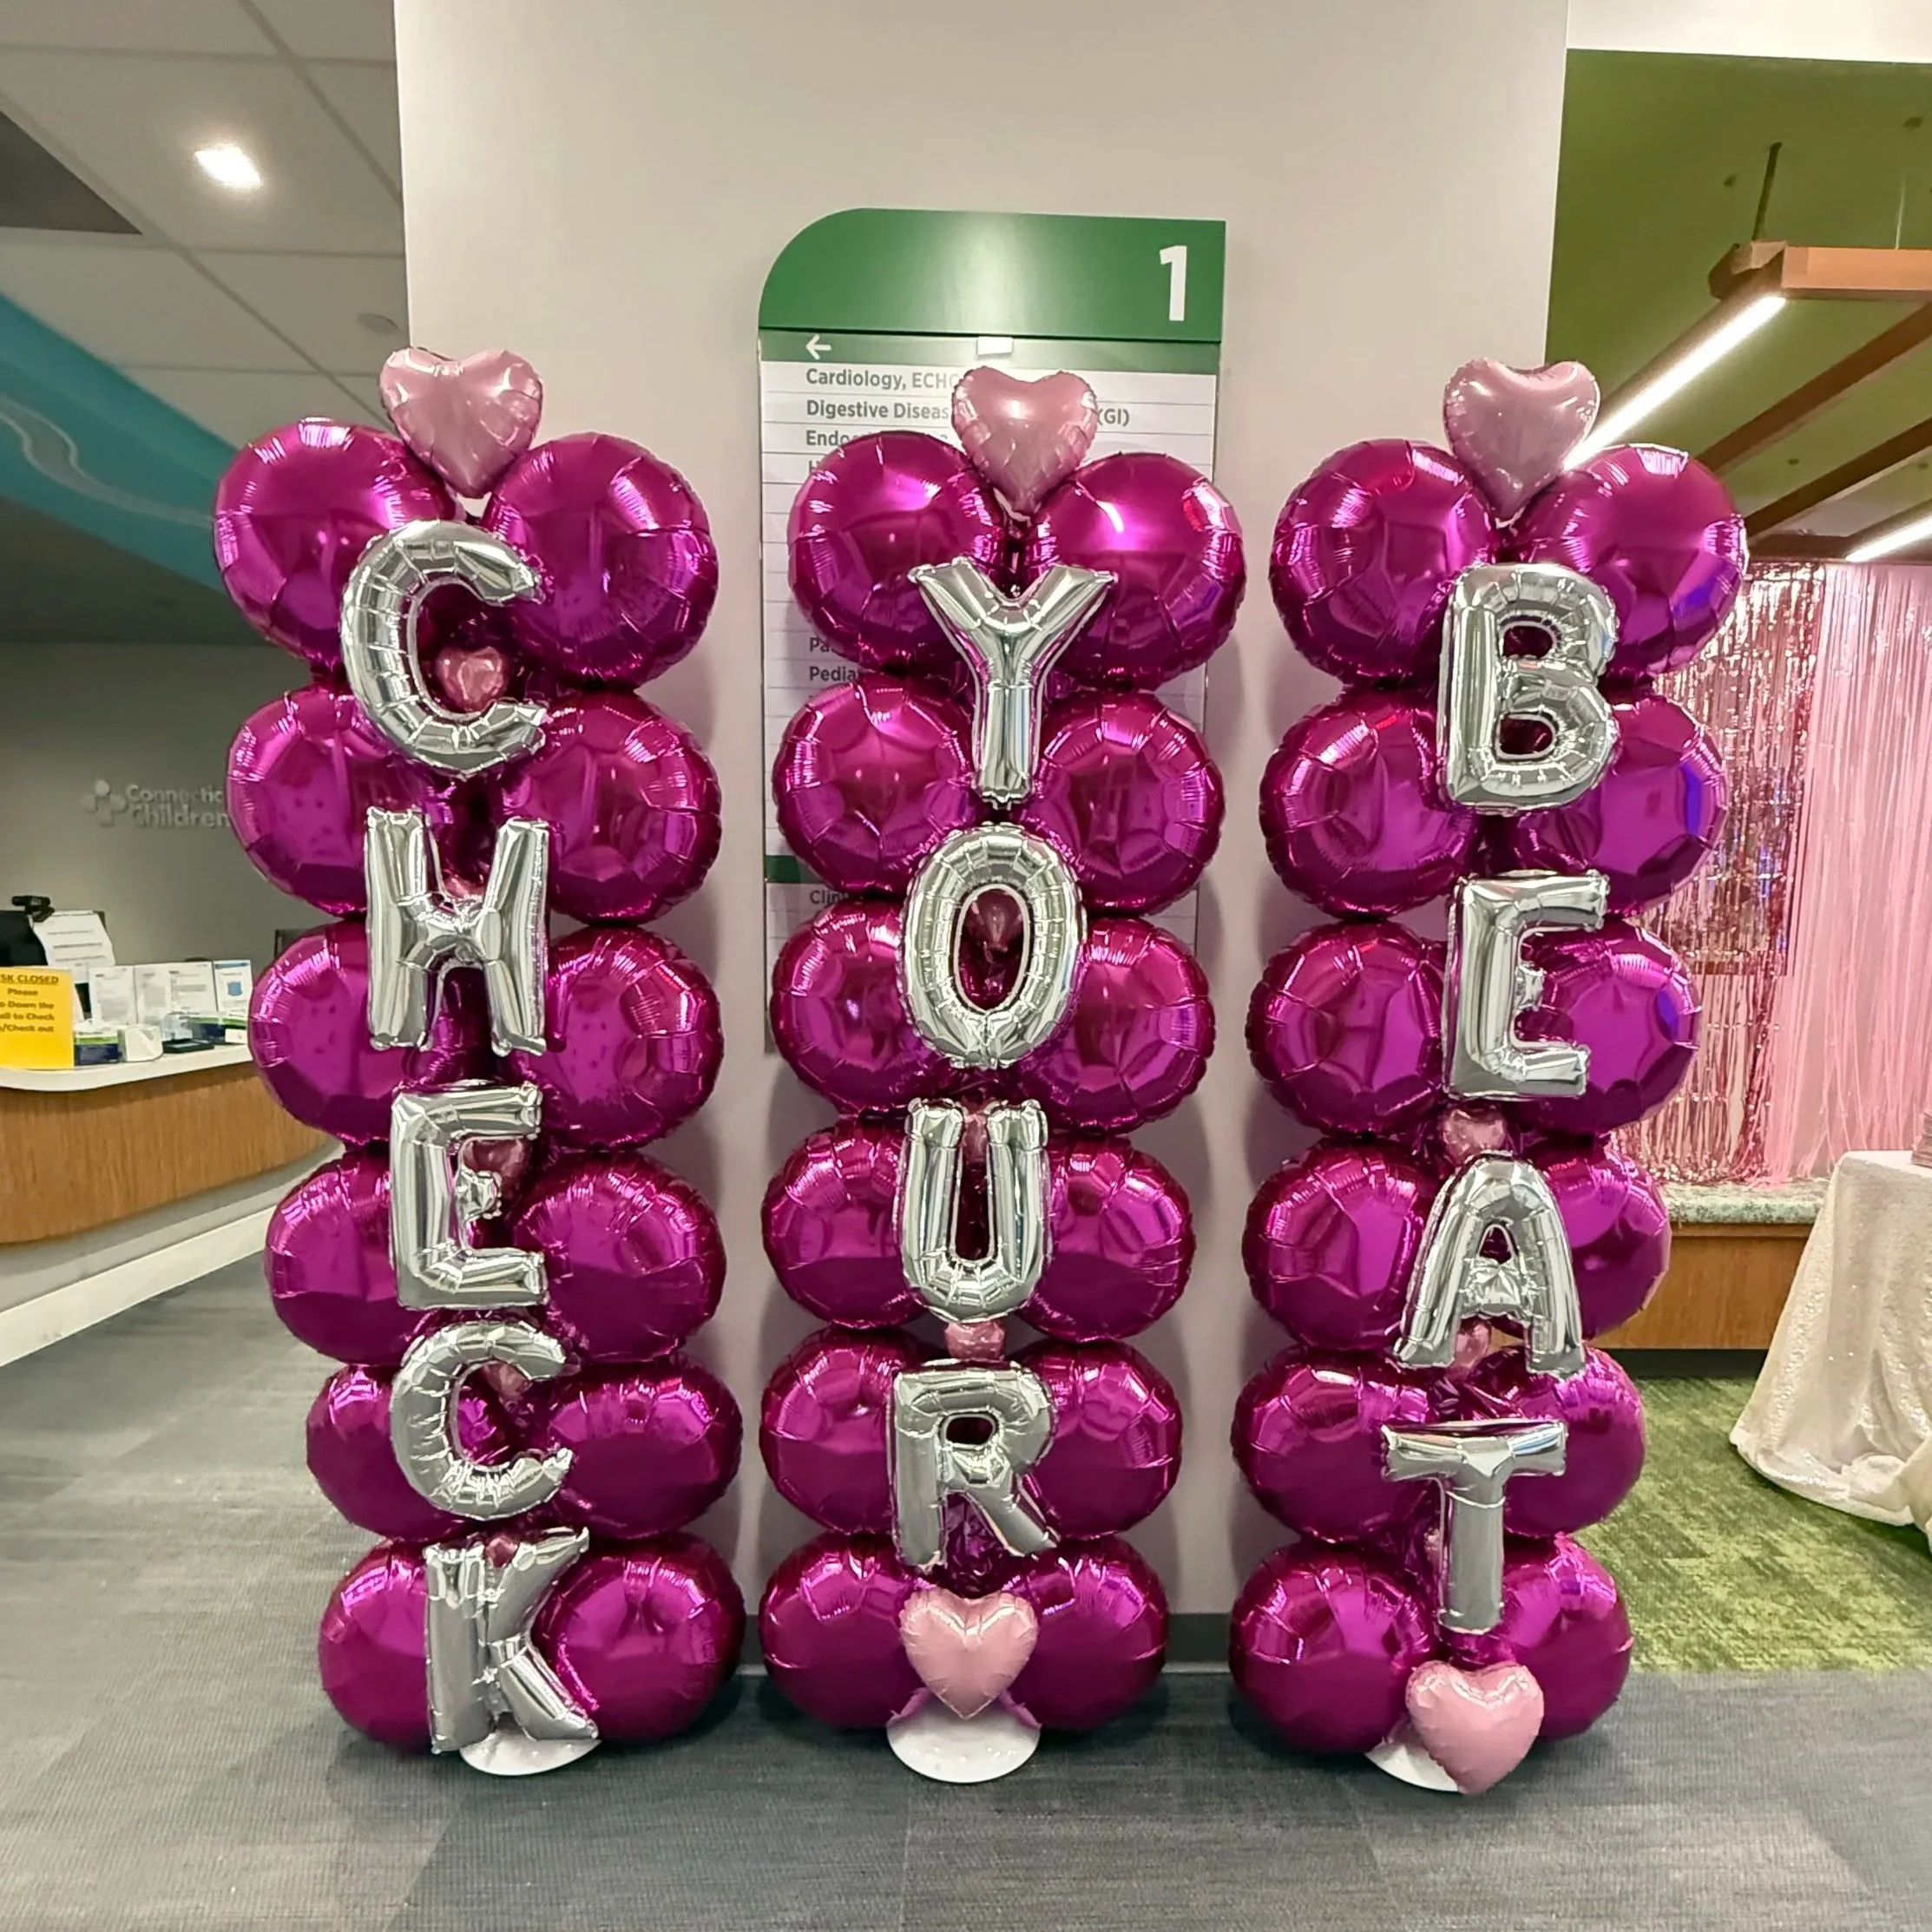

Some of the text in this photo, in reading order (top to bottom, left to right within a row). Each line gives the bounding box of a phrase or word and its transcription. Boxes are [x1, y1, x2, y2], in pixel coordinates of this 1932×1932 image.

[1160, 245, 1187, 321] 1
[806, 368, 906, 391] Cardiology,
[806, 399, 1130, 427] Digestive Diseas (GI)
[805, 430, 856, 447] Endo
[809, 637, 831, 653] Pa
[809, 666, 857, 682] Pedia
[810, 890, 841, 904] Clin
[0, 974, 59, 984] SK CLOSED
[26, 1012, 56, 1022] Check
